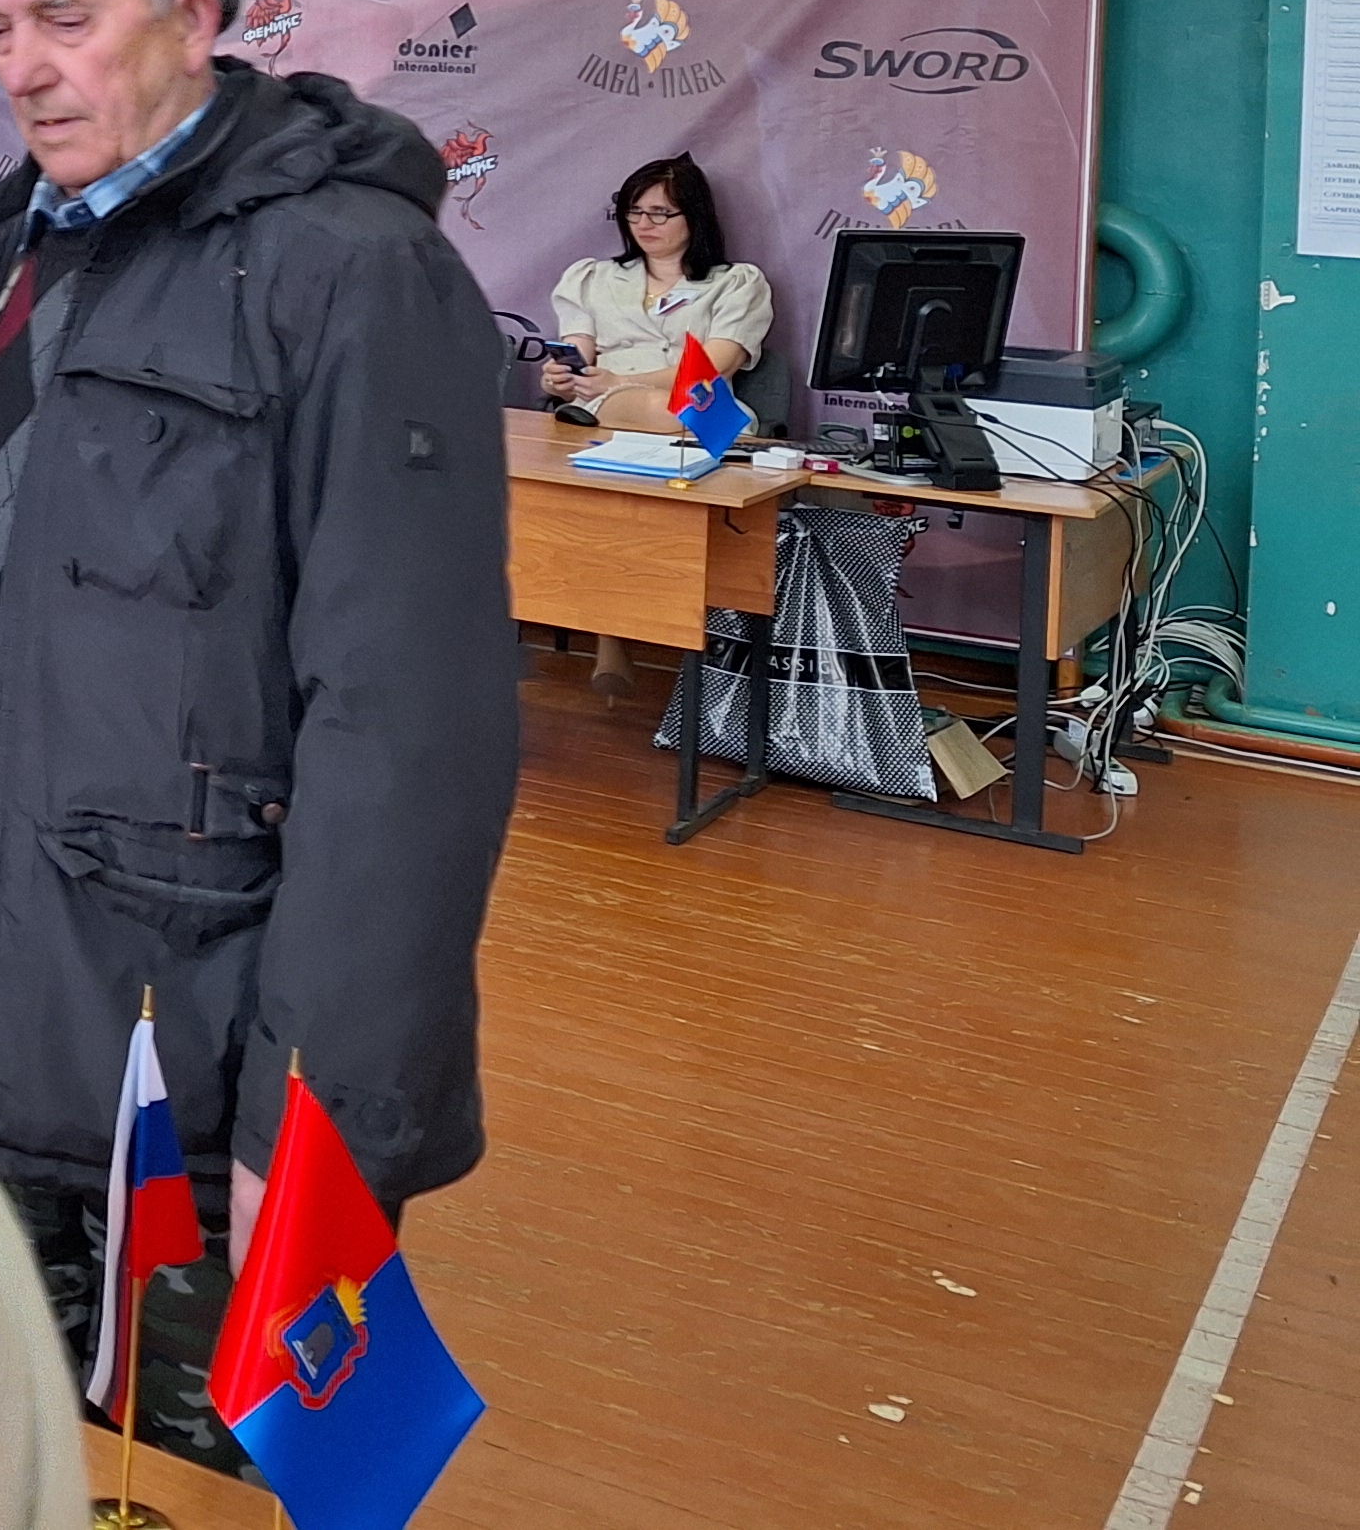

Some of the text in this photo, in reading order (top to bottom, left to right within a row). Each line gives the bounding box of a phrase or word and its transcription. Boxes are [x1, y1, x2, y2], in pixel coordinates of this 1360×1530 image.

[243, 14, 300, 41] ФЕНИКС
[399, 38, 474, 58] donier
[393, 60, 475, 74] International
[447, 157, 496, 181] ЕНИКС
